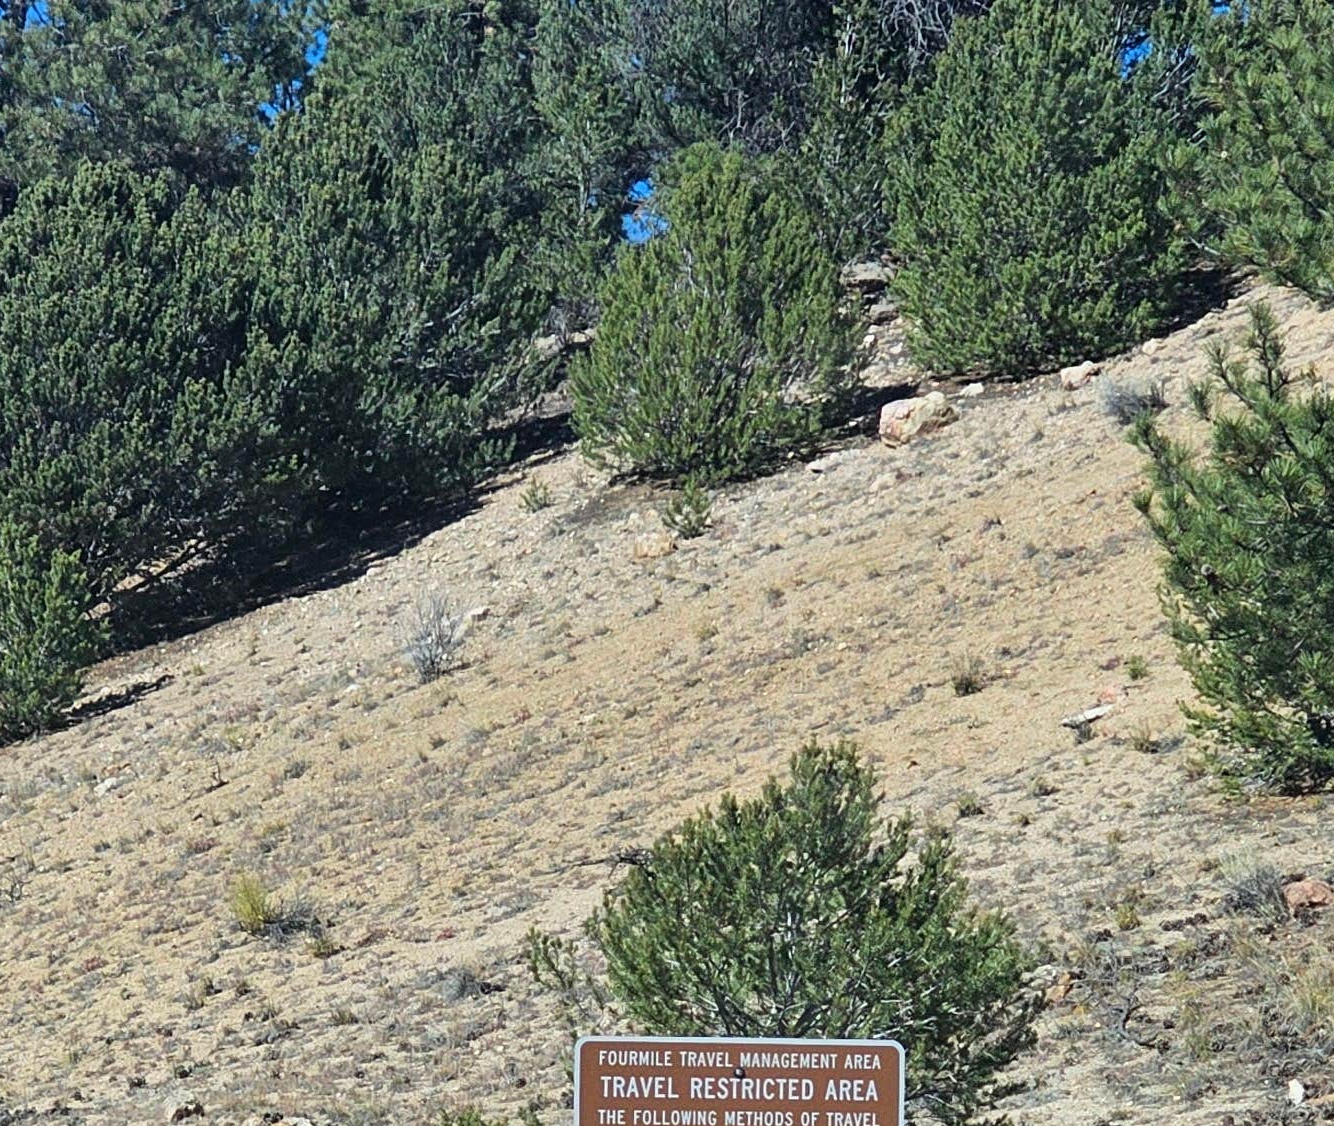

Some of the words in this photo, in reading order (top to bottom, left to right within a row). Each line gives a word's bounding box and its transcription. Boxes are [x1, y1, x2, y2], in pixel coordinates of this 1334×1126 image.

[599, 1051, 672, 1066] FOURMILE
[680, 1052, 733, 1067] TRAVEL
[740, 1053, 837, 1069] MANAGEMENT
[844, 1054, 881, 1069] AREA
[601, 1076, 679, 1098] TRAVEL
[691, 1077, 814, 1100] RESTRICTED
[825, 1080, 878, 1101] AREA
[598, 1110, 625, 1125] THE
[634, 1111, 717, 1126] FOLLOWING
[725, 1112, 793, 1126] METHODS
[801, 1112, 819, 1126] OF
[826, 1113, 880, 1126] TRAVEL
